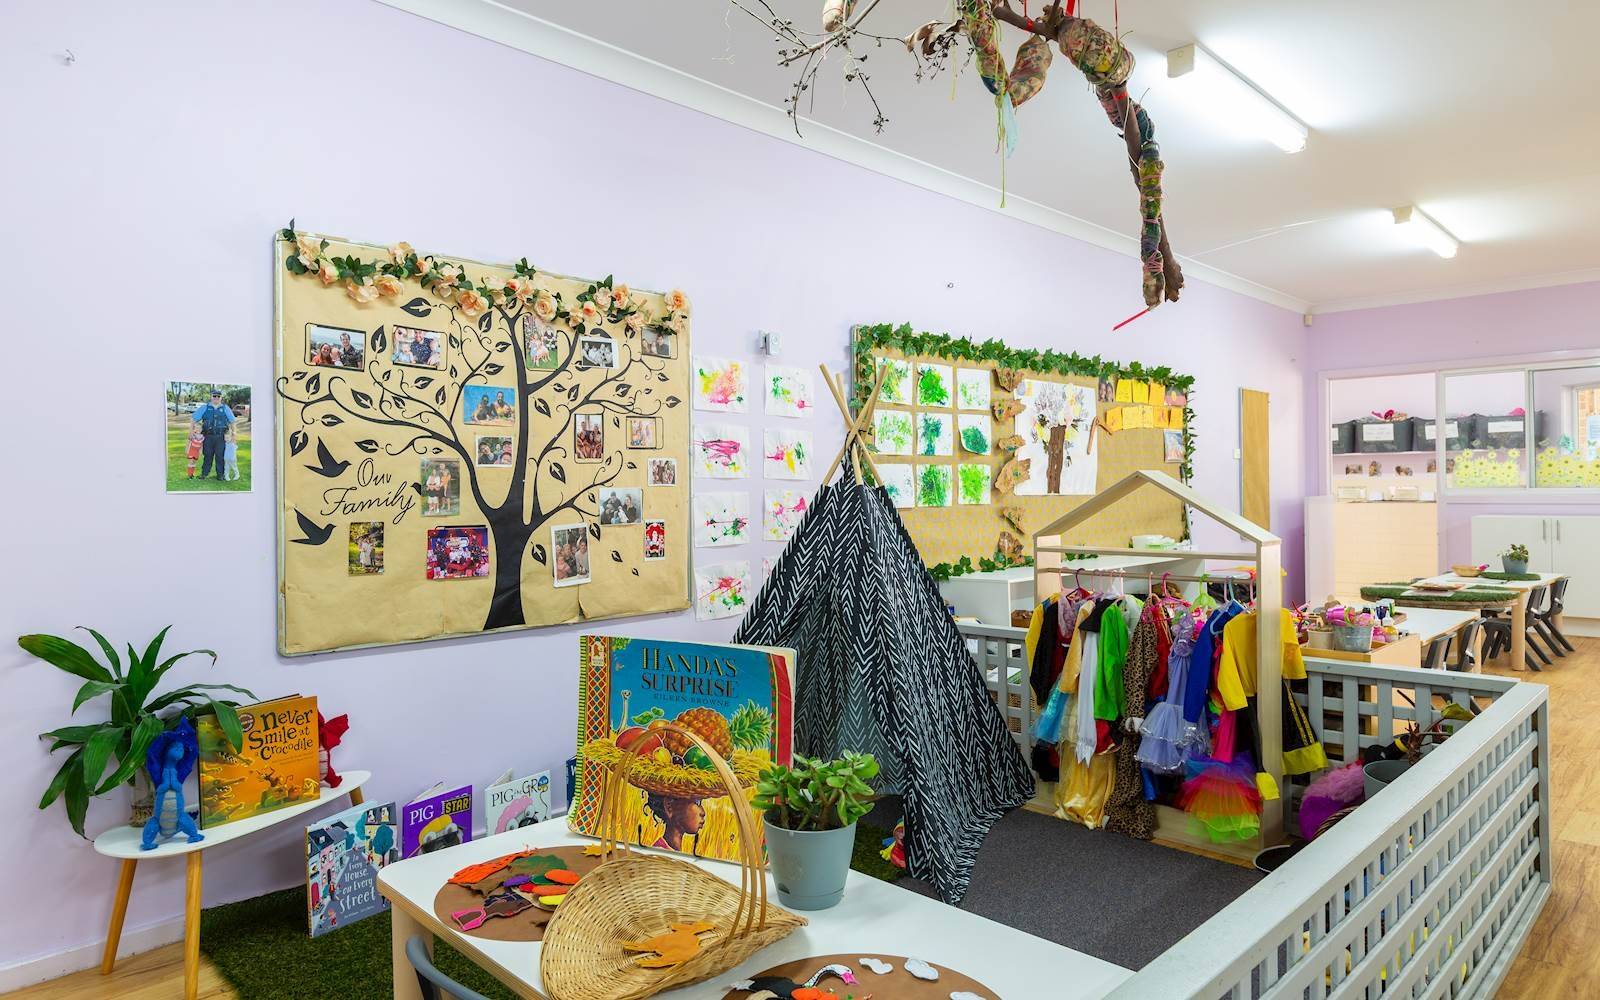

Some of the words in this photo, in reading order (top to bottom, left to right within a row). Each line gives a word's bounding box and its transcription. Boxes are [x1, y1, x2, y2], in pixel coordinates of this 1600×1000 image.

[357, 457, 392, 487] Our
[320, 481, 416, 524] Family
[641, 673, 738, 698] SURPRISE
[654, 693, 687, 703] EILEEN
[690, 697, 730, 707] BROWNE
[248, 726, 297, 750] Smile
[298, 726, 310, 736] at
[491, 788, 514, 807] PIG
[409, 805, 434, 826] PIG
[445, 797, 469, 814] STAR
[349, 862, 363, 871] Every
[342, 885, 352, 895] on
[353, 878, 373, 891] Every
[339, 886, 376, 914] Street
